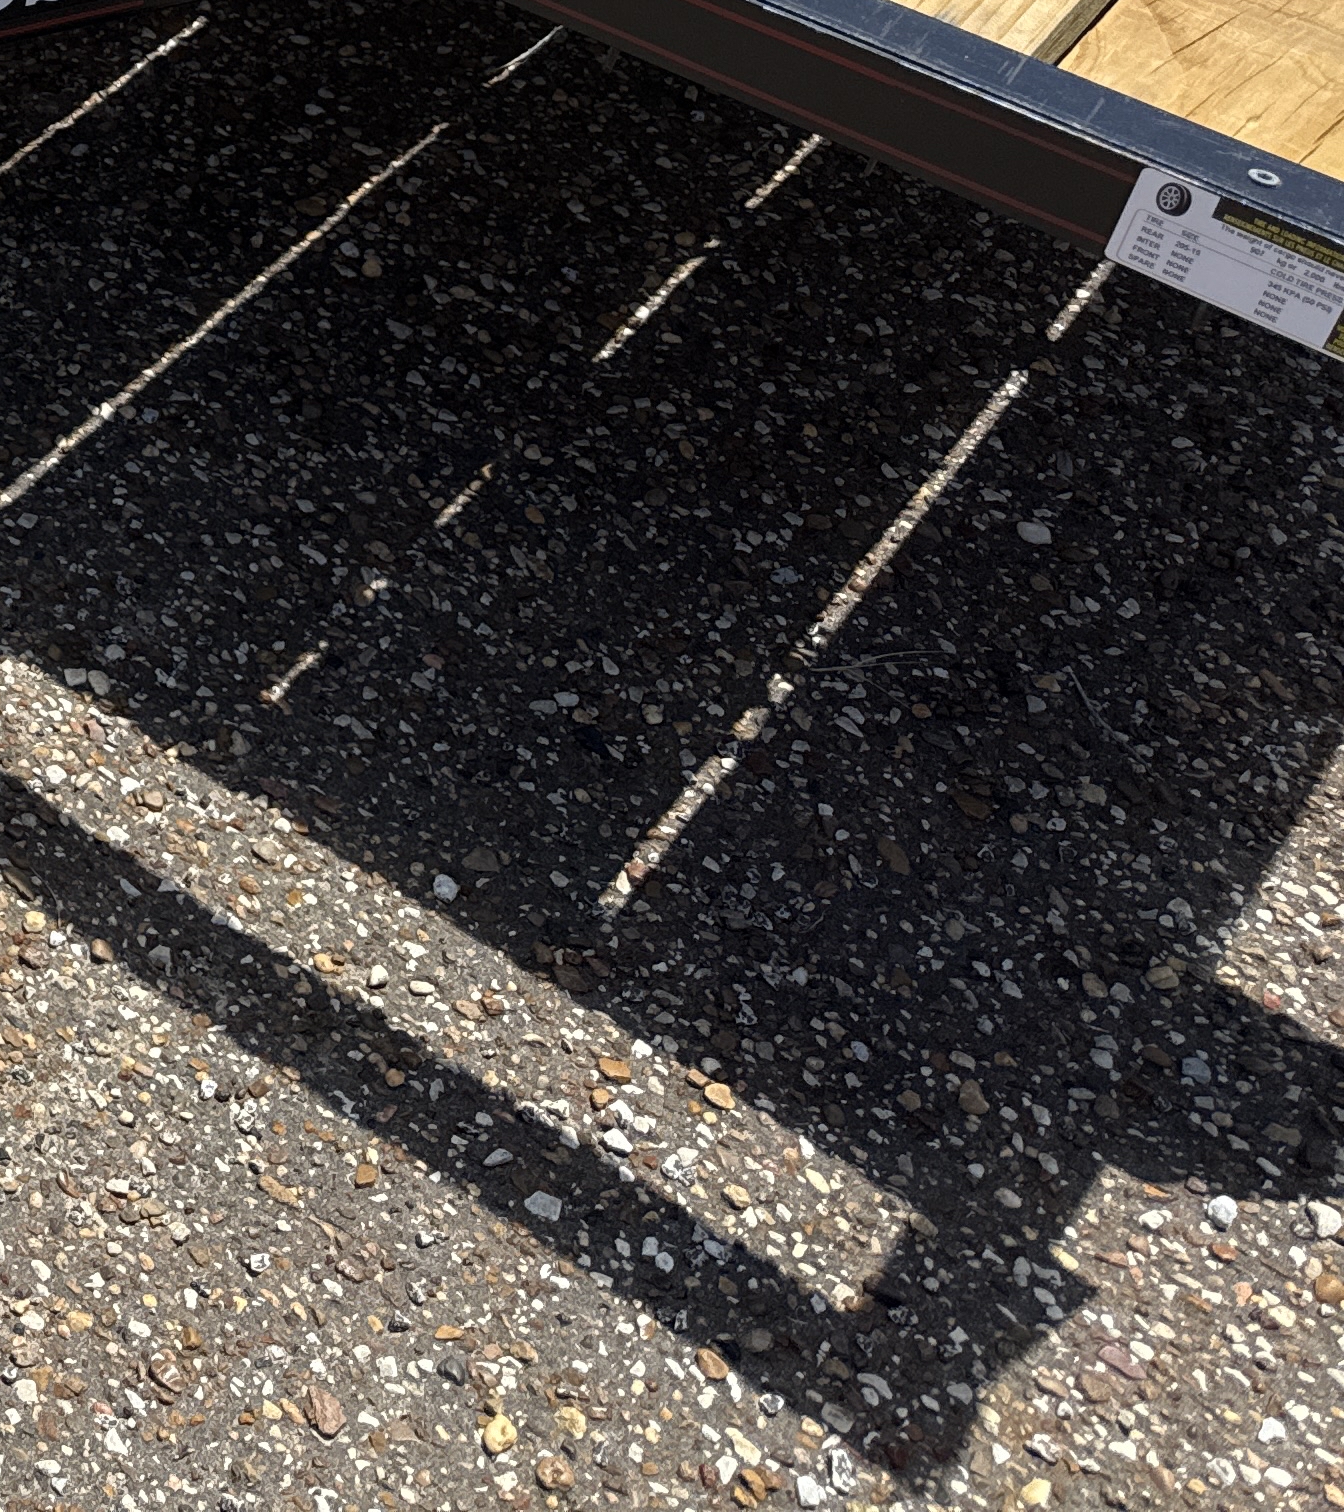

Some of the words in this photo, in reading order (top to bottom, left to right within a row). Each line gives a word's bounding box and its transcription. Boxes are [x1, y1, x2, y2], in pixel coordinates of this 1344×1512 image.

[1146, 214, 1164, 227] TIRE
[1141, 225, 1164, 240] REAR
[1221, 223, 1236, 235] The
[1263, 242, 1274, 251] of
[1273, 247, 1296, 260] cargo
[1297, 257, 1325, 273] should
[1132, 244, 1161, 260] FRONT
[1166, 259, 1190, 274] NONE
[1170, 249, 1195, 265] NONE
[1127, 253, 1156, 269] SPARE
[1162, 268, 1186, 283] NONE
[1270, 268, 1295, 283] COLD
[1295, 278, 1314, 292] TIRE
[1262, 289, 1287, 306] NONE
[1283, 287, 1301, 300] KPA
[1253, 307, 1279, 324] NONE
[1257, 299, 1283, 315] NONE
